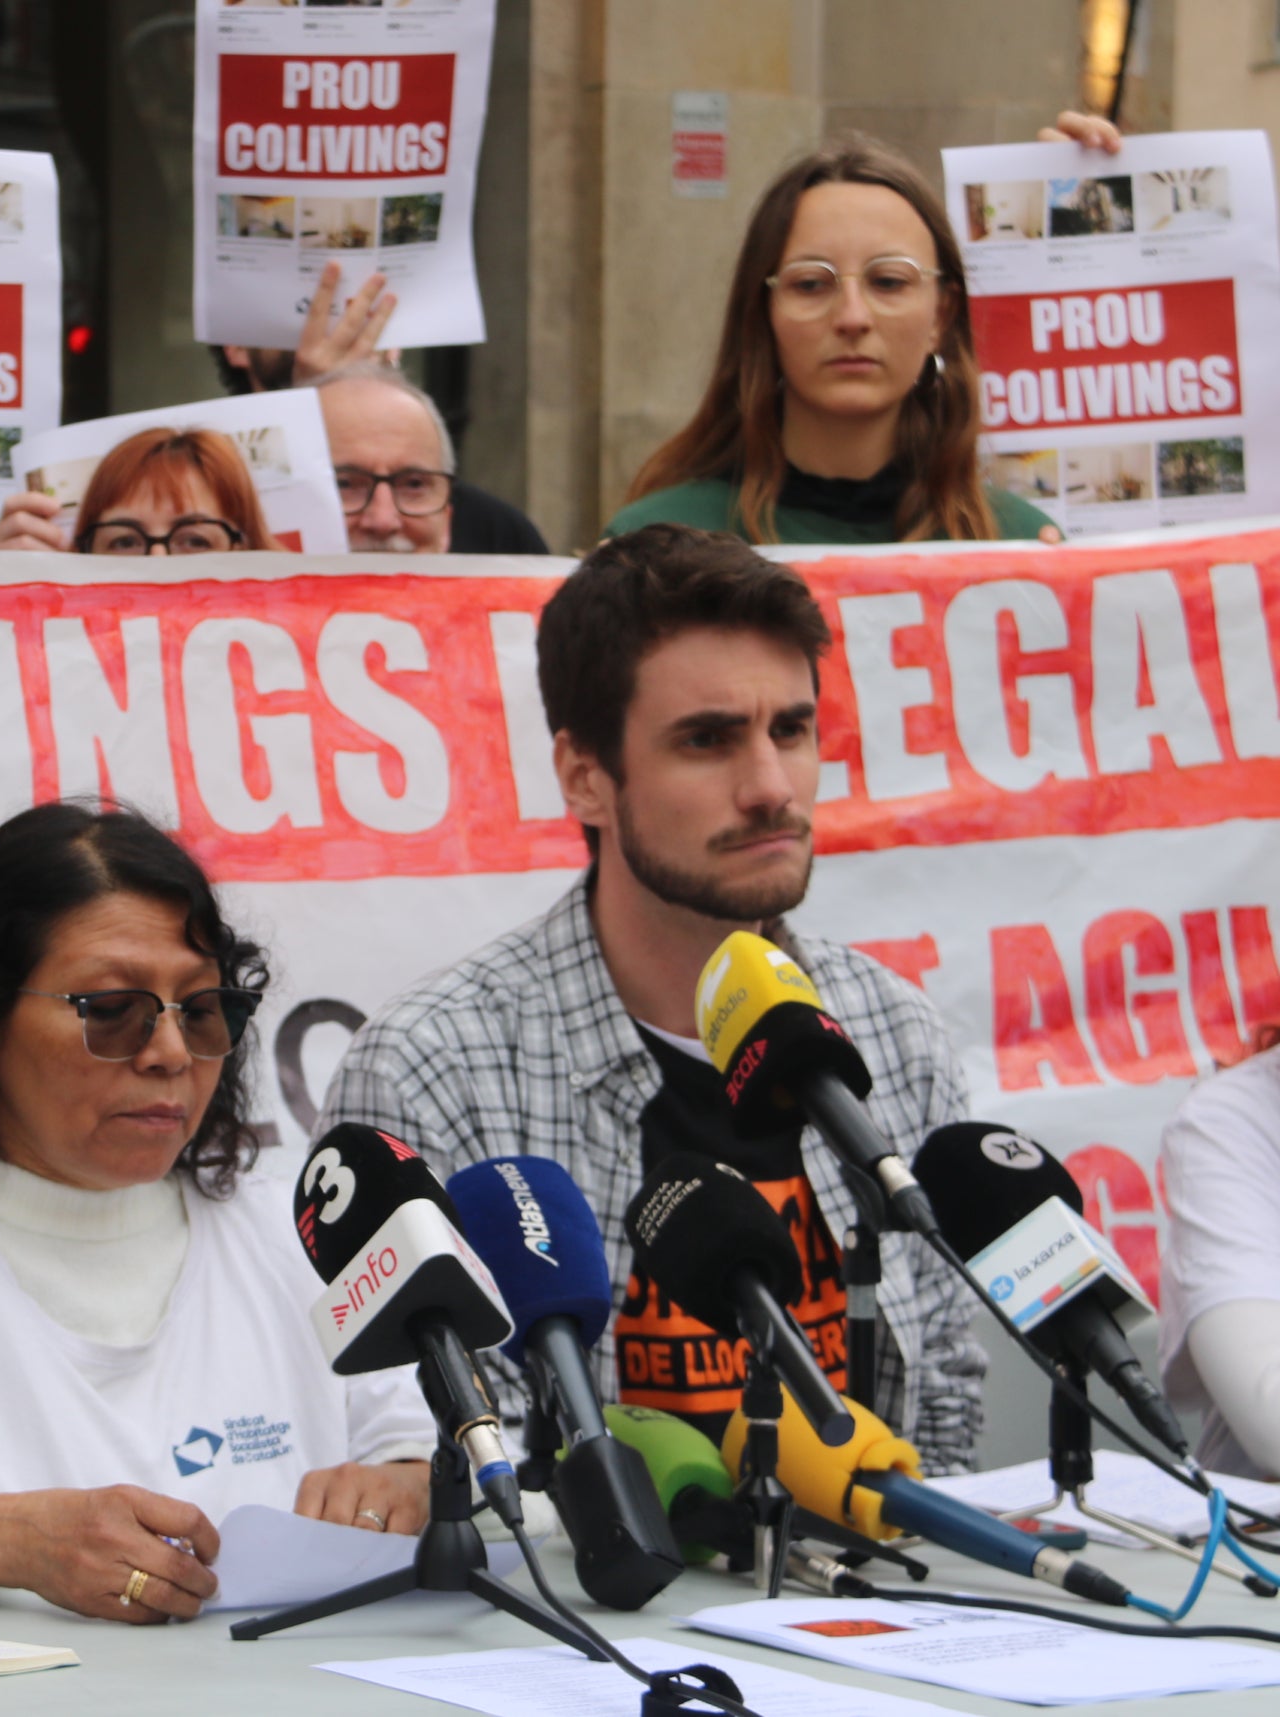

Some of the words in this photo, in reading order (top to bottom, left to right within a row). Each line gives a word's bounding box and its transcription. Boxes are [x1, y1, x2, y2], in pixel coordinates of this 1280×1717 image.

[282, 61, 401, 110] PROU
[223, 122, 447, 174] COLIVINGS
[1029, 290, 1166, 353] PROU
[977, 354, 1237, 427] COLIVINGS
[304, 1147, 356, 1225] 3
[641, 1180, 683, 1239] CATALANA
[645, 1228, 657, 1247] DE
[1013, 1264, 1032, 1281] la
[1030, 1231, 1076, 1268] xarxa
[343, 1246, 398, 1314] info
[624, 1340, 674, 1385] DE
[223, 1414, 266, 1430] Sindicat
